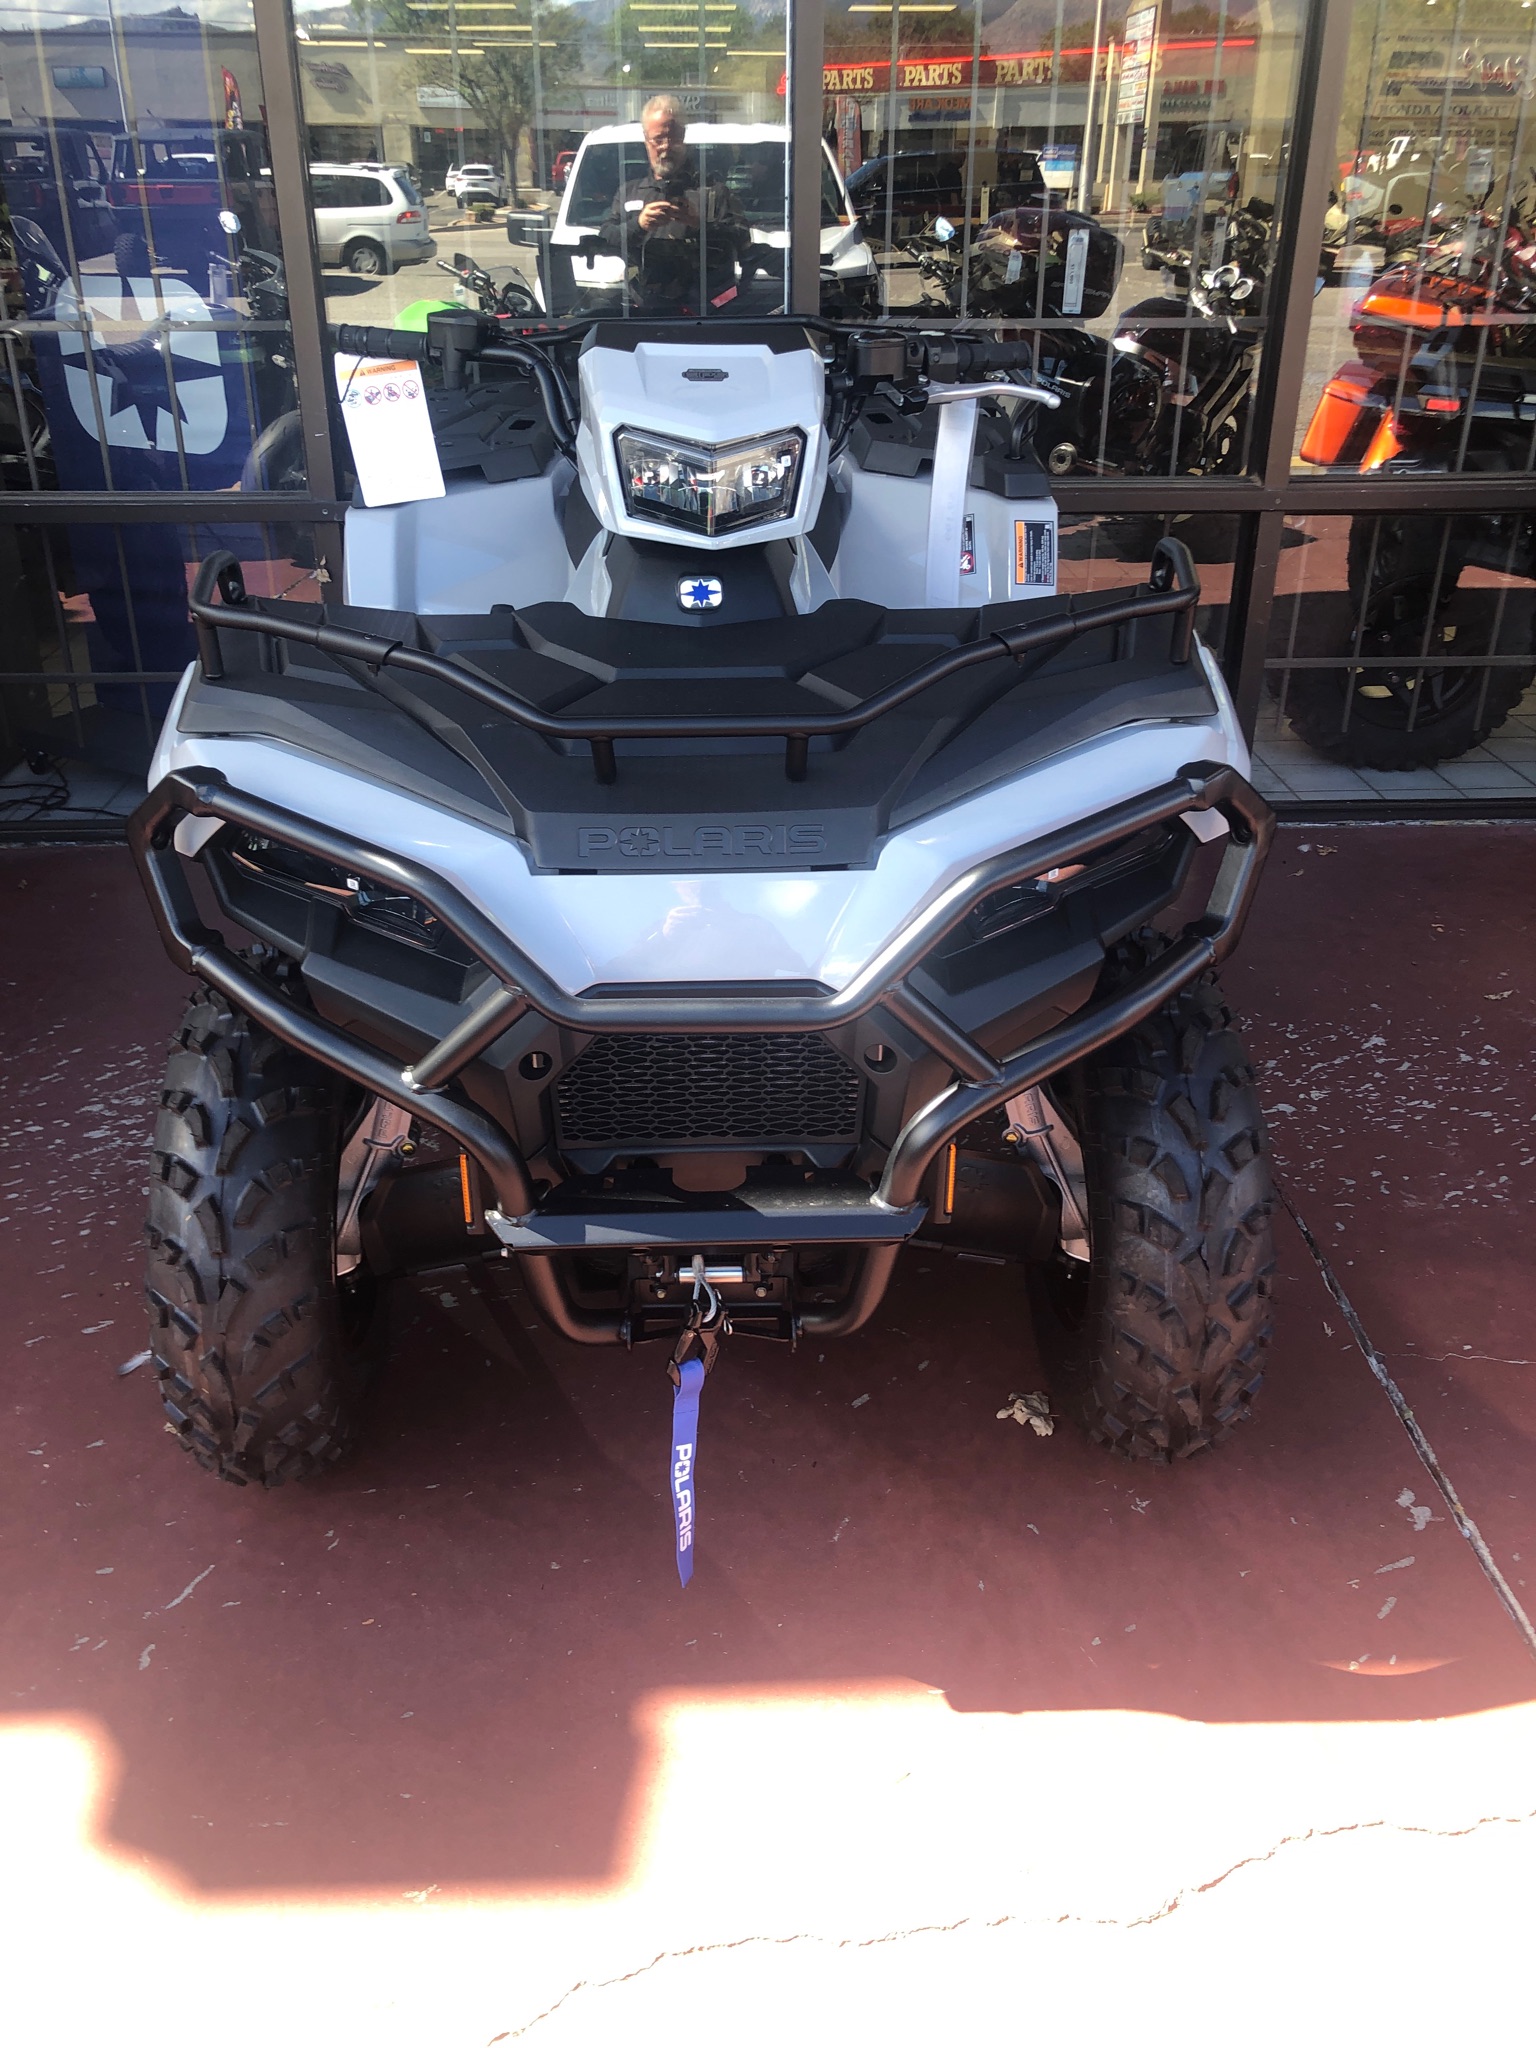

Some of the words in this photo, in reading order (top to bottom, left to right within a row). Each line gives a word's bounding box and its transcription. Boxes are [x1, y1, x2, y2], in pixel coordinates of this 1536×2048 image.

[823, 67, 874, 90] PARTS
[903, 62, 962, 87] PARTS
[366, 364, 397, 376] WARNING
[1035, 376, 1072, 400] POLARIS
[577, 824, 827, 858] POLARIS
[675, 1443, 693, 1552] POLARIS
